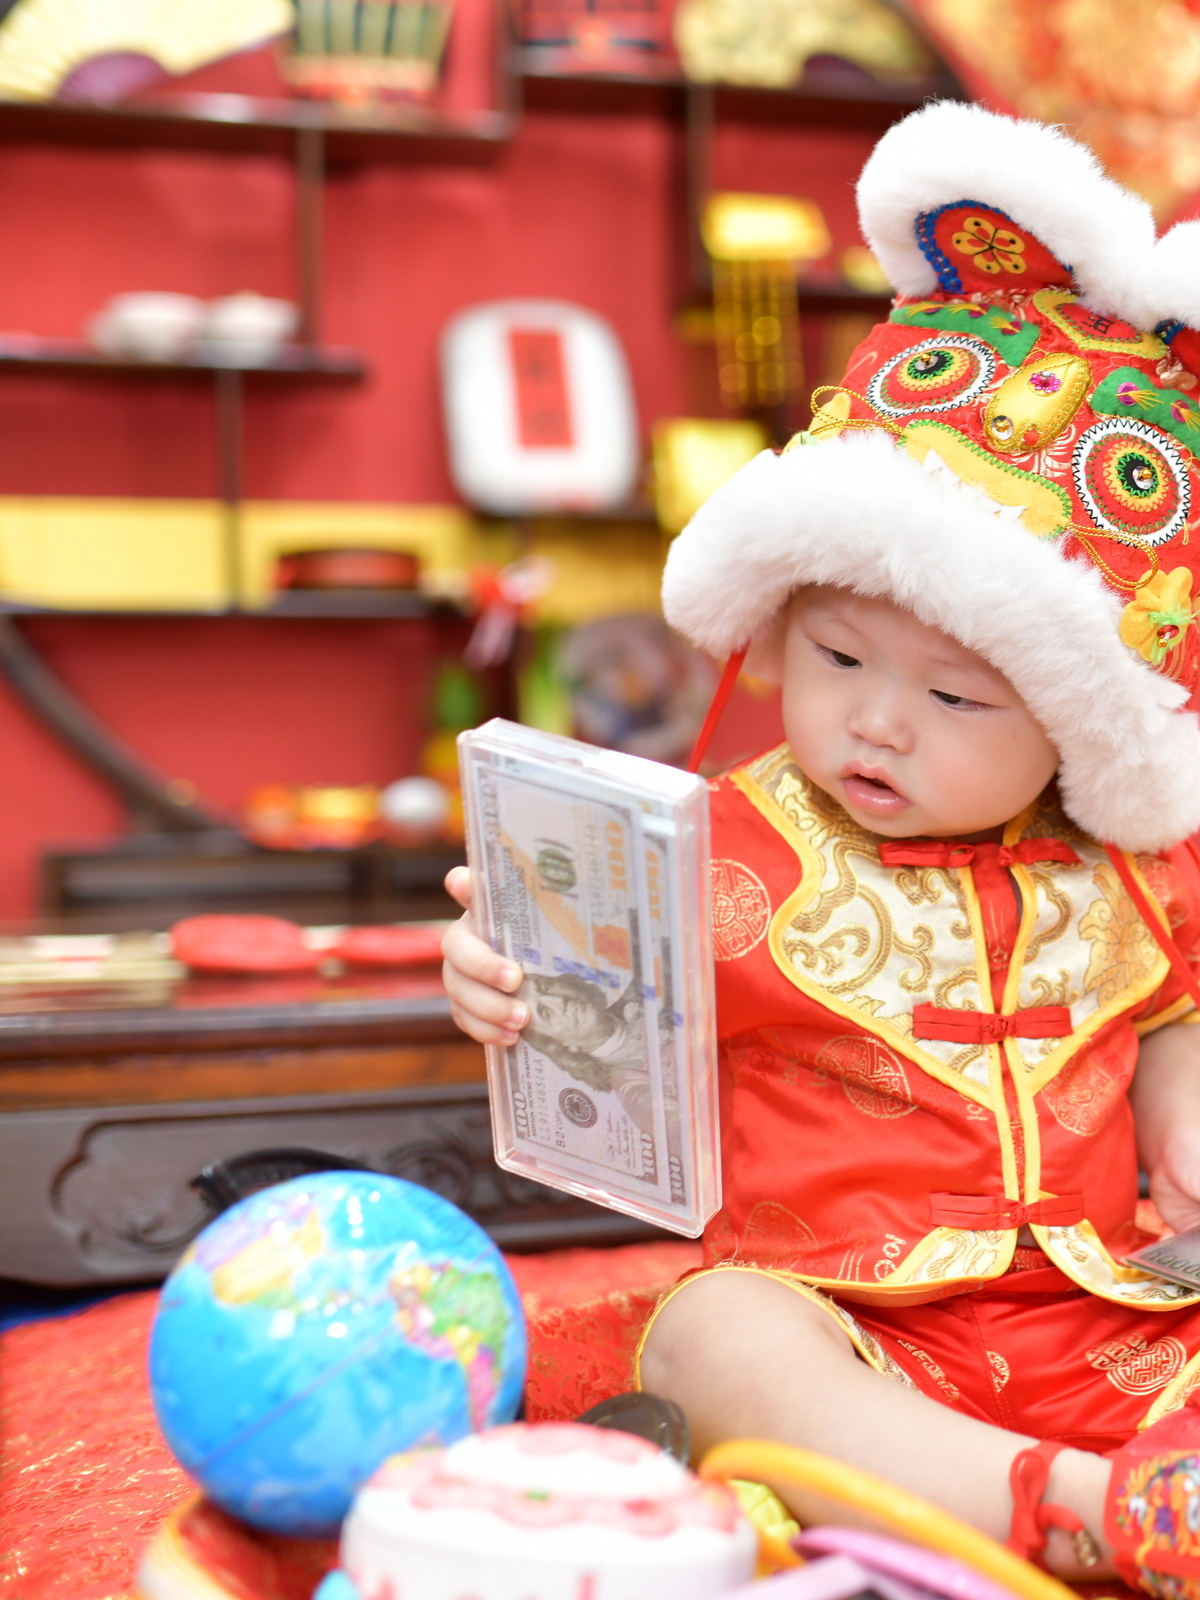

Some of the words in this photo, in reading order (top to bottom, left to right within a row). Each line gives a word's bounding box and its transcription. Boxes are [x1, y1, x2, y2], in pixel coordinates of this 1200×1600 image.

[513, 1091, 530, 1138] 100
[641, 1131, 656, 1178] 100
[668, 1155, 684, 1203] 100
